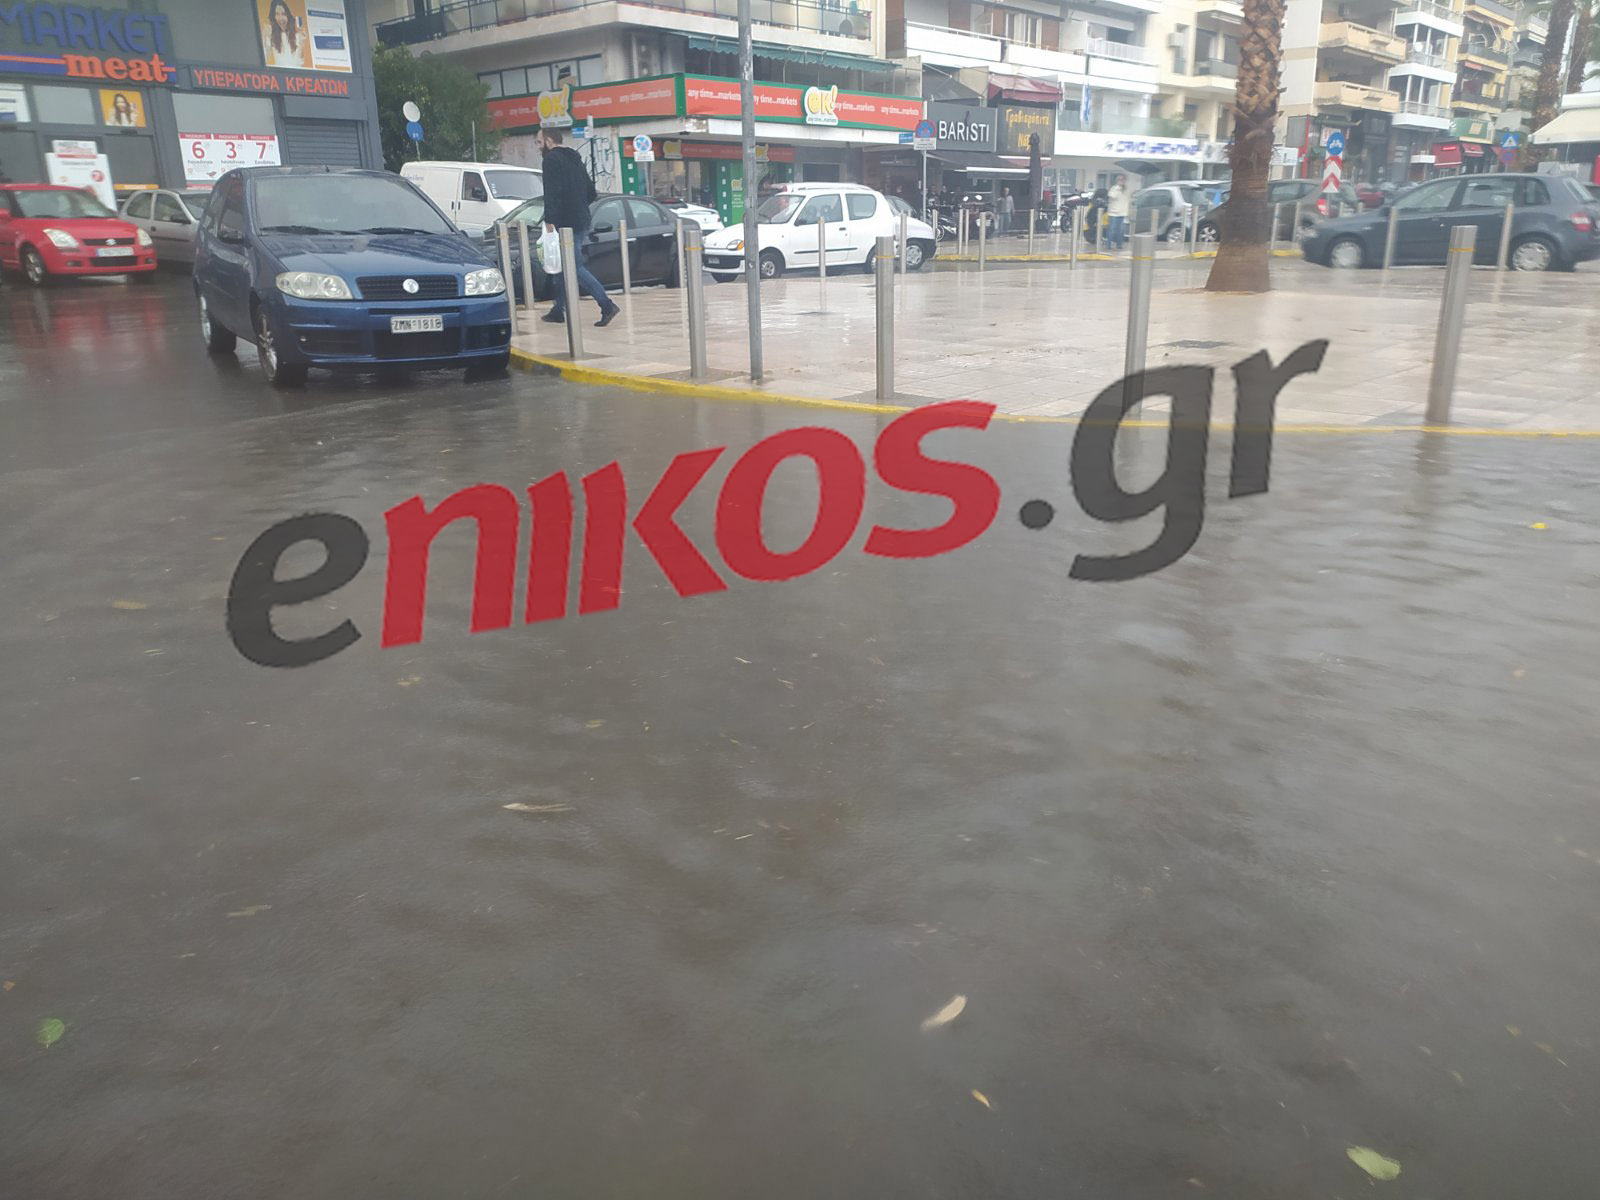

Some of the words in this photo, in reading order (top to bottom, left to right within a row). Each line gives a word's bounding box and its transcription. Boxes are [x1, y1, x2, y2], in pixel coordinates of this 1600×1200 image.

[63, 53, 168, 82] meat
[194, 69, 280, 91] ΥΠΕΡΑΓΟΡΑ
[286, 76, 349, 96] ΚΡΕΑΤΩΝ
[687, 88, 699, 100] any
[807, 85, 838, 115] OK!
